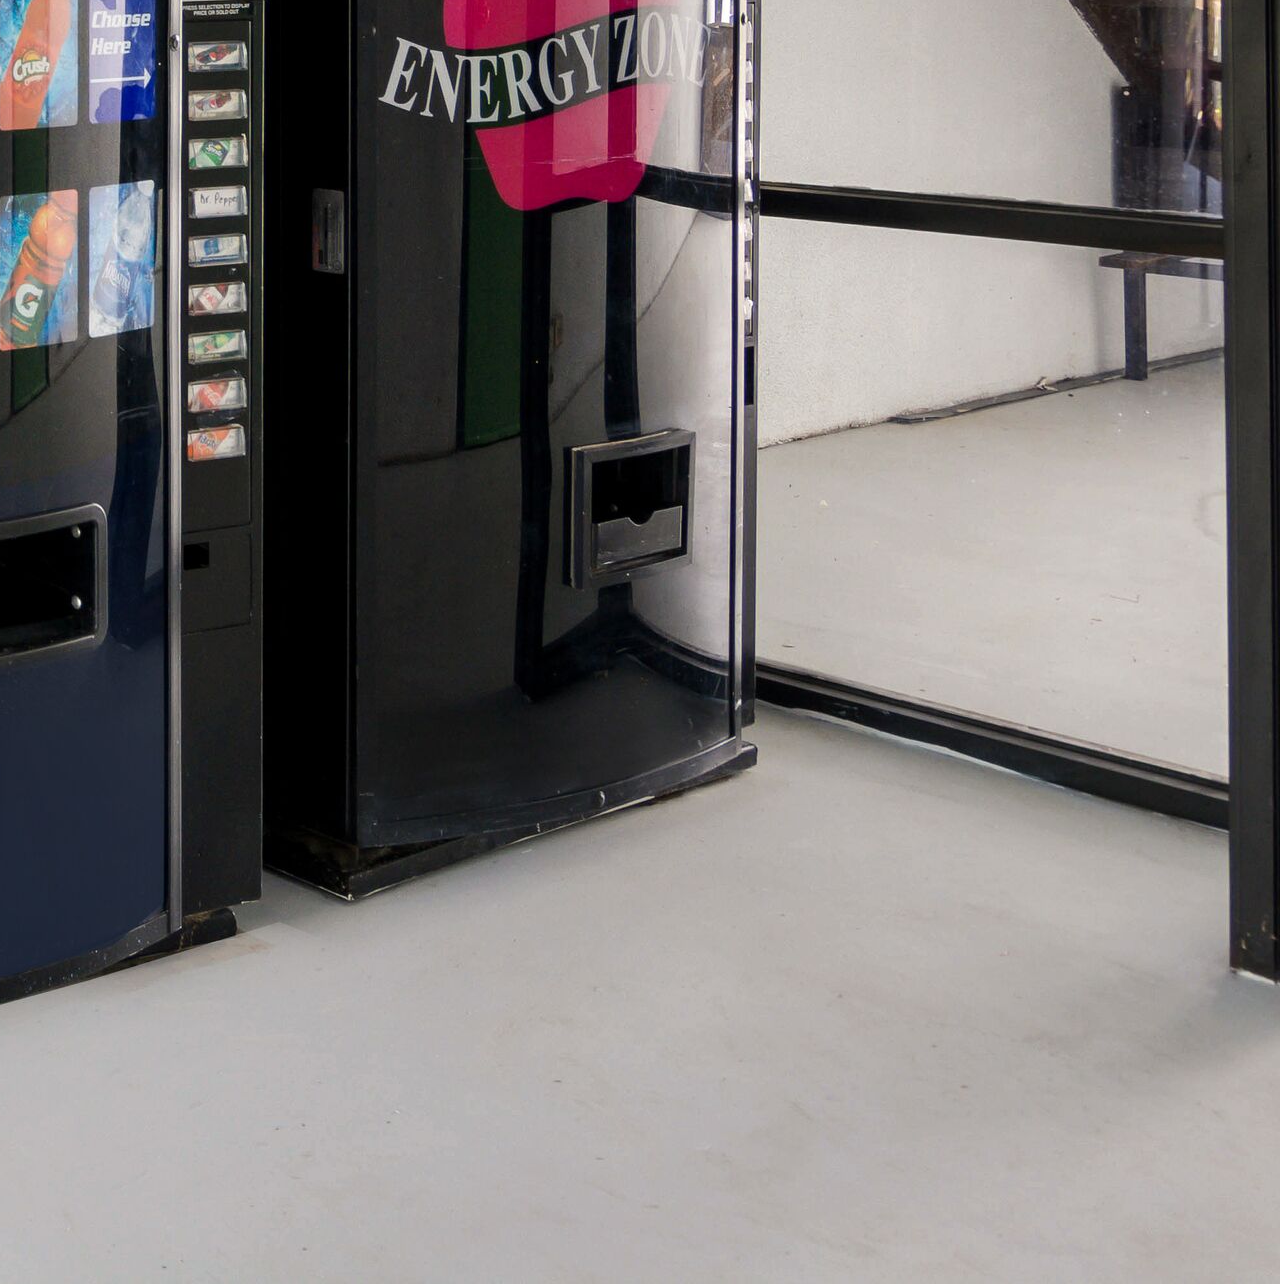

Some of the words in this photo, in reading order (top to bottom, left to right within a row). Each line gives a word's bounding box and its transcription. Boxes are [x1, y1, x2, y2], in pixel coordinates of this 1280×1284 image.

[92, 10, 151, 28] Choose
[91, 37, 132, 55] Here
[13, 57, 50, 82] Crush
[378, 24, 602, 124] ENERGY
[613, 11, 714, 89] ZONE
[15, 283, 44, 318] G
